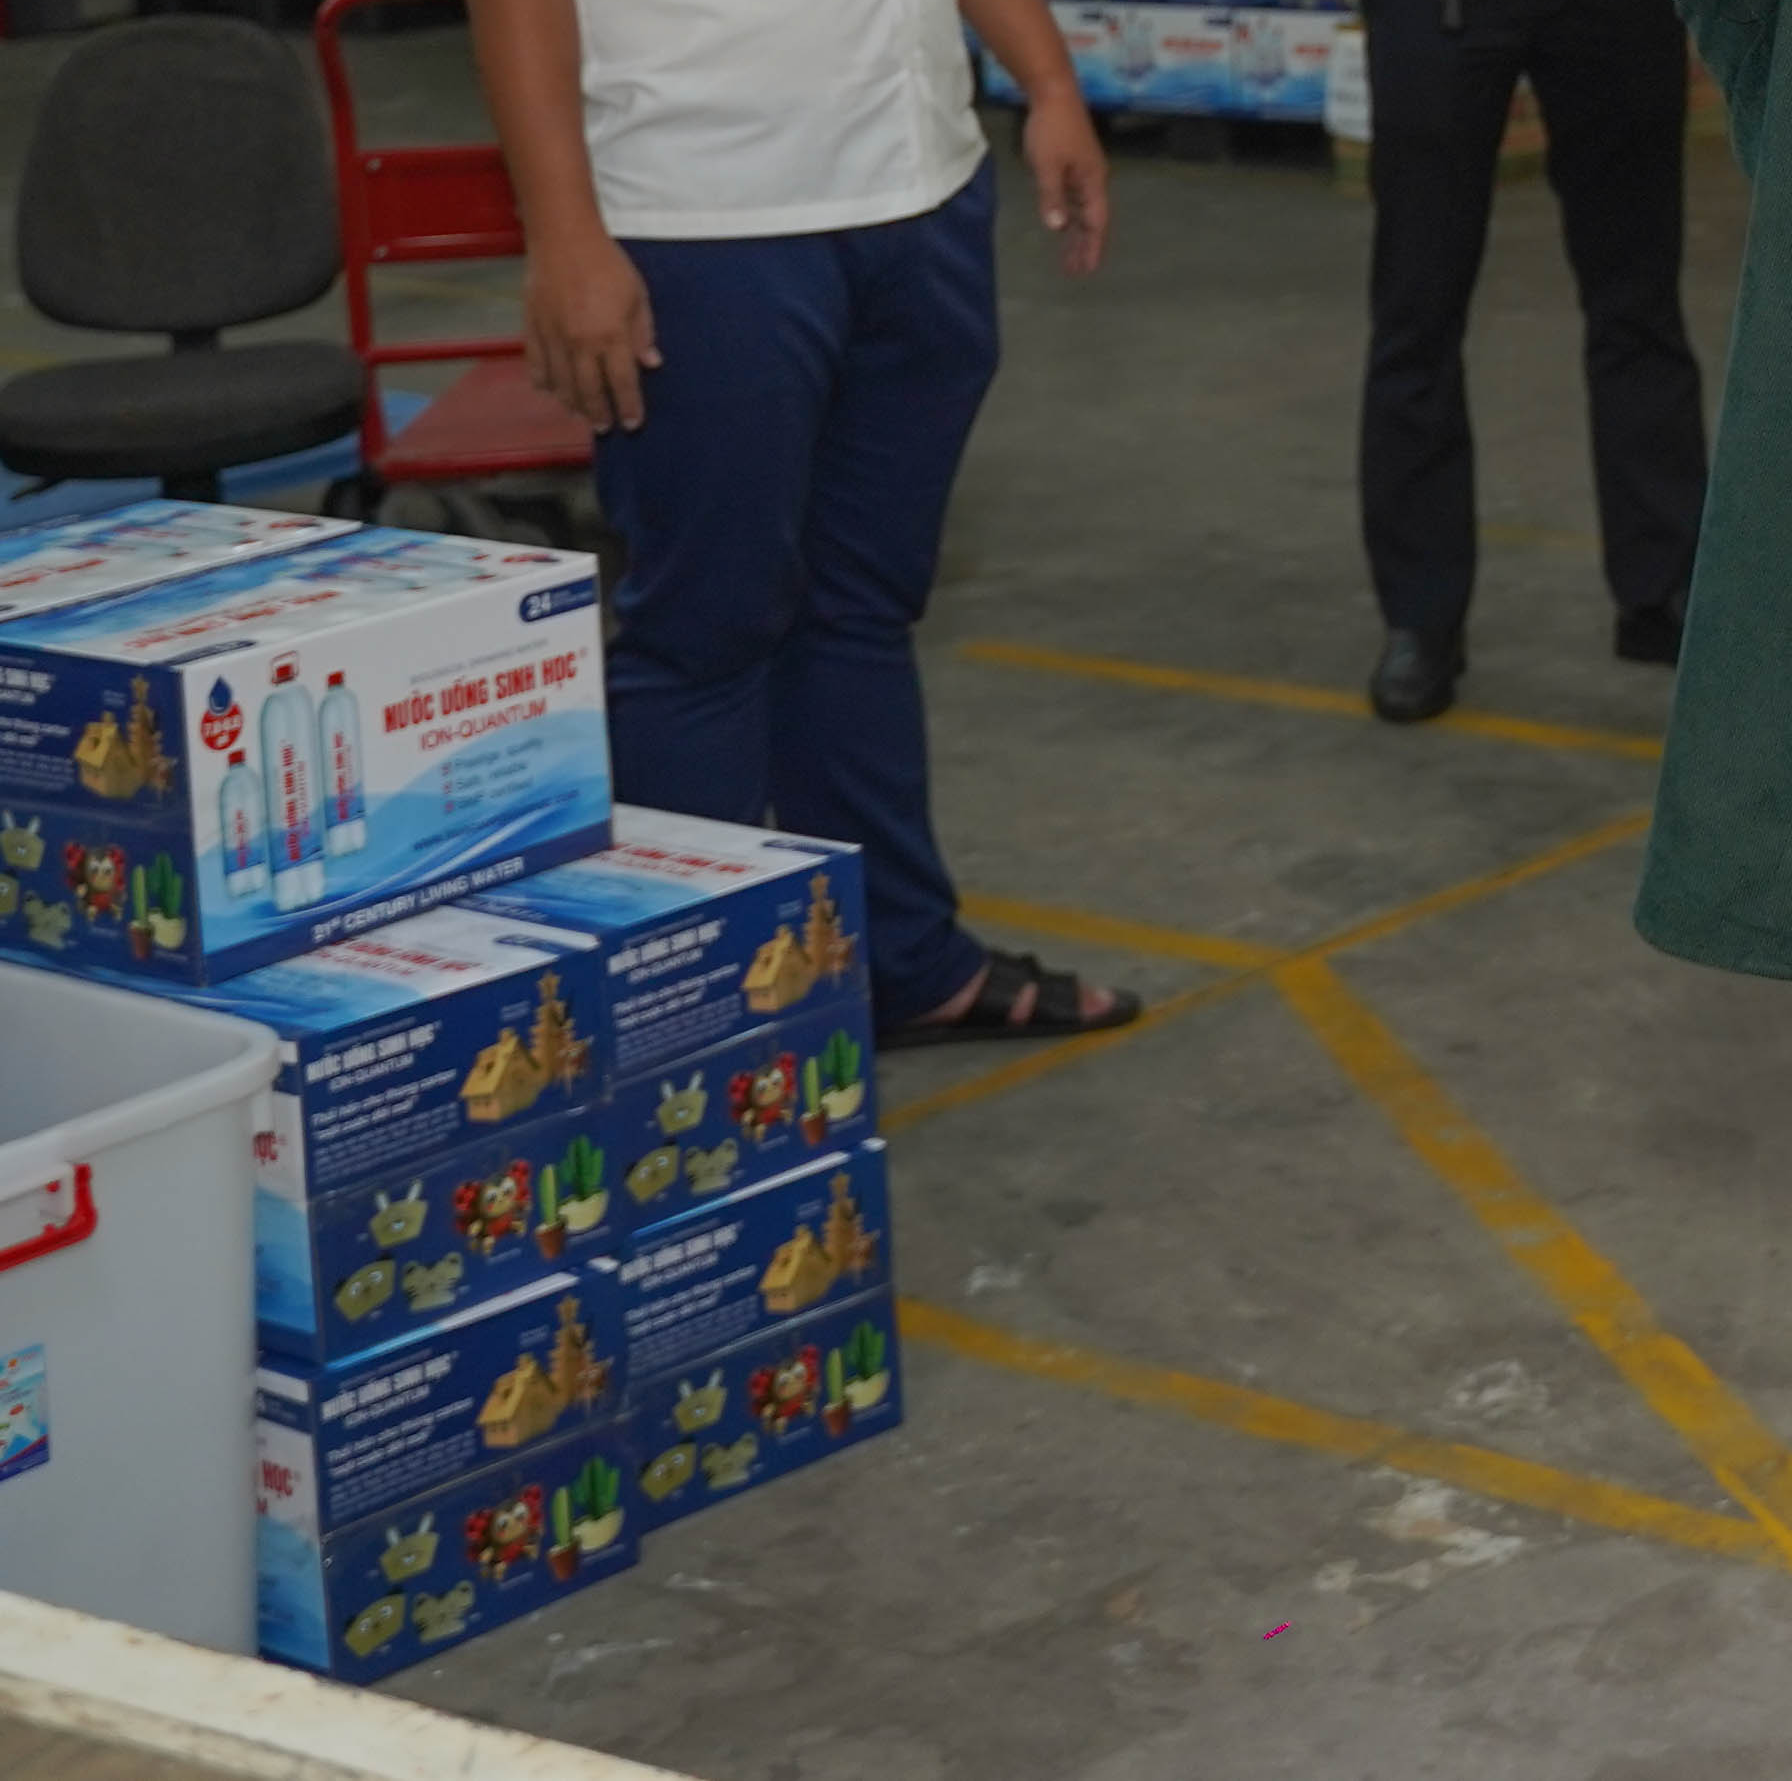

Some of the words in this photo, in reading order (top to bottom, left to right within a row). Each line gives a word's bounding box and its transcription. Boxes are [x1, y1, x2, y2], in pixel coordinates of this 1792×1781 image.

[526, 591, 552, 614] 24
[495, 664, 536, 701] SINH
[542, 650, 578, 691] HỌC
[420, 697, 547, 751] ION-QUANTUM
[342, 891, 417, 934] CENTURY
[418, 872, 470, 911] LIVING
[471, 855, 527, 893] WATER
[262, 1458, 294, 1501] HỌC
